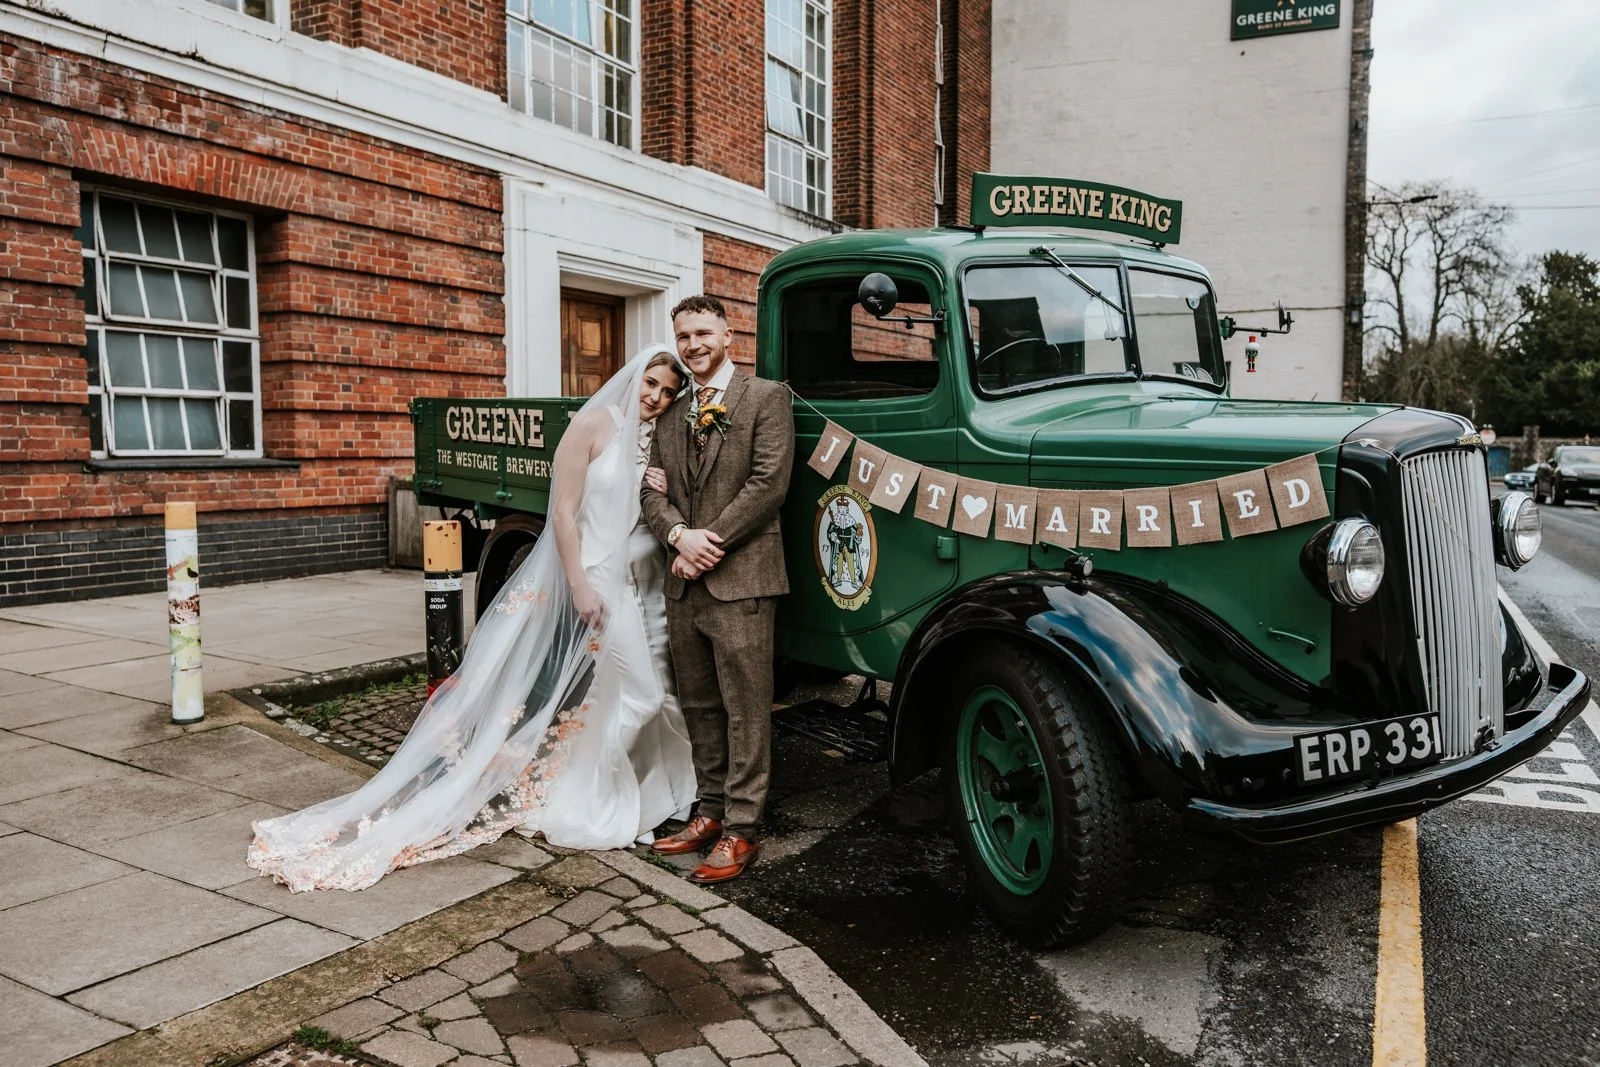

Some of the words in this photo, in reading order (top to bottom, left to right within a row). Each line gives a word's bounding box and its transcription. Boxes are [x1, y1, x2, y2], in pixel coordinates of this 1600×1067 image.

[1236, 9, 1293, 26] GREENE
[1297, 4, 1336, 19] KING
[989, 185, 1105, 218] GREENE
[1108, 192, 1172, 232] KING
[446, 406, 545, 448] GREENE
[437, 449, 452, 465] THE
[455, 452, 498, 472] WESTGATE
[820, 436, 946, 510] JUST
[1004, 478, 1311, 535] MARRIED
[822, 486, 847, 504] GREENE
[851, 490, 868, 509] KING
[837, 598, 855, 607] ALES
[1300, 729, 1371, 781] ERP
[1384, 716, 1442, 765] 331
